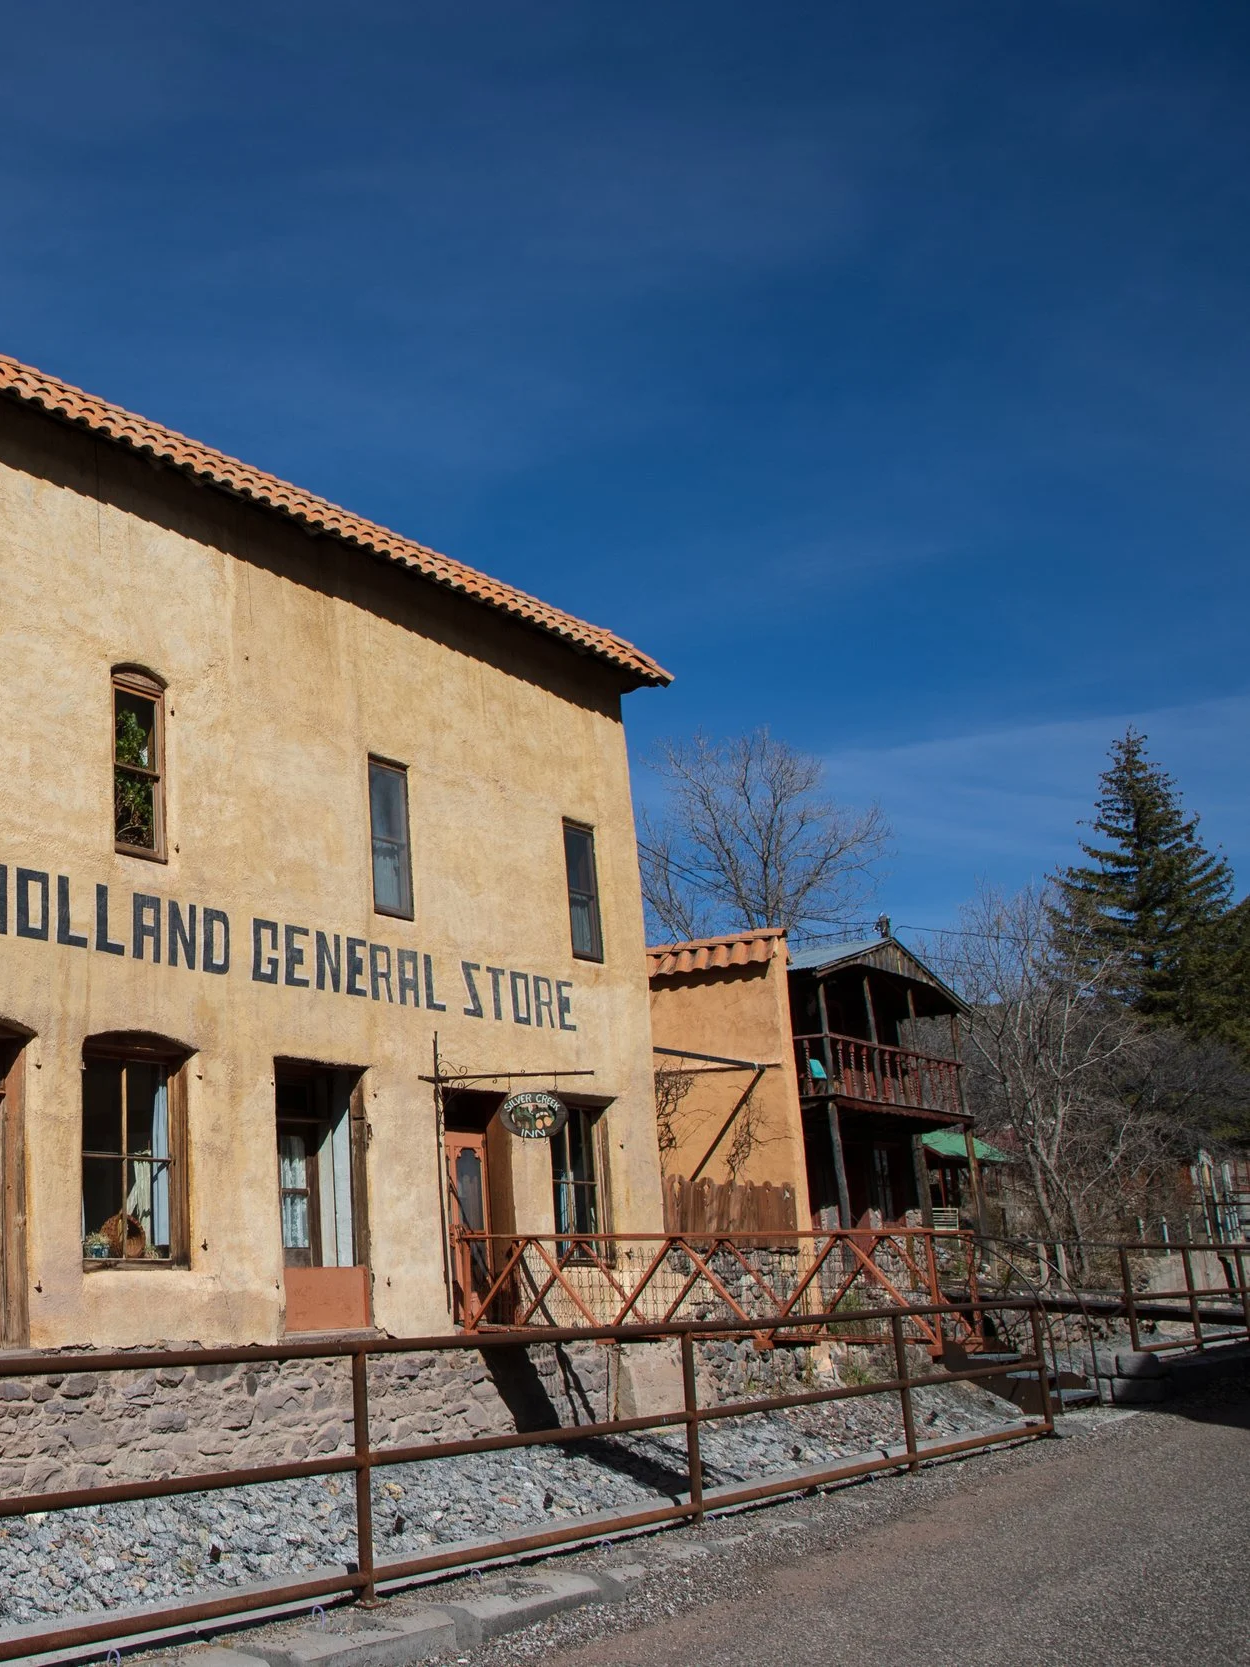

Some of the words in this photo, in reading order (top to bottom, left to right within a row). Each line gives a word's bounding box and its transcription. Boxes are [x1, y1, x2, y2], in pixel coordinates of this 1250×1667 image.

[251, 917, 447, 1012] GENERAL
[461, 960, 577, 1032] STORE
[503, 1094, 532, 1112] SILVER
[535, 1094, 561, 1111] CREEK
[520, 1128, 546, 1138] INN
